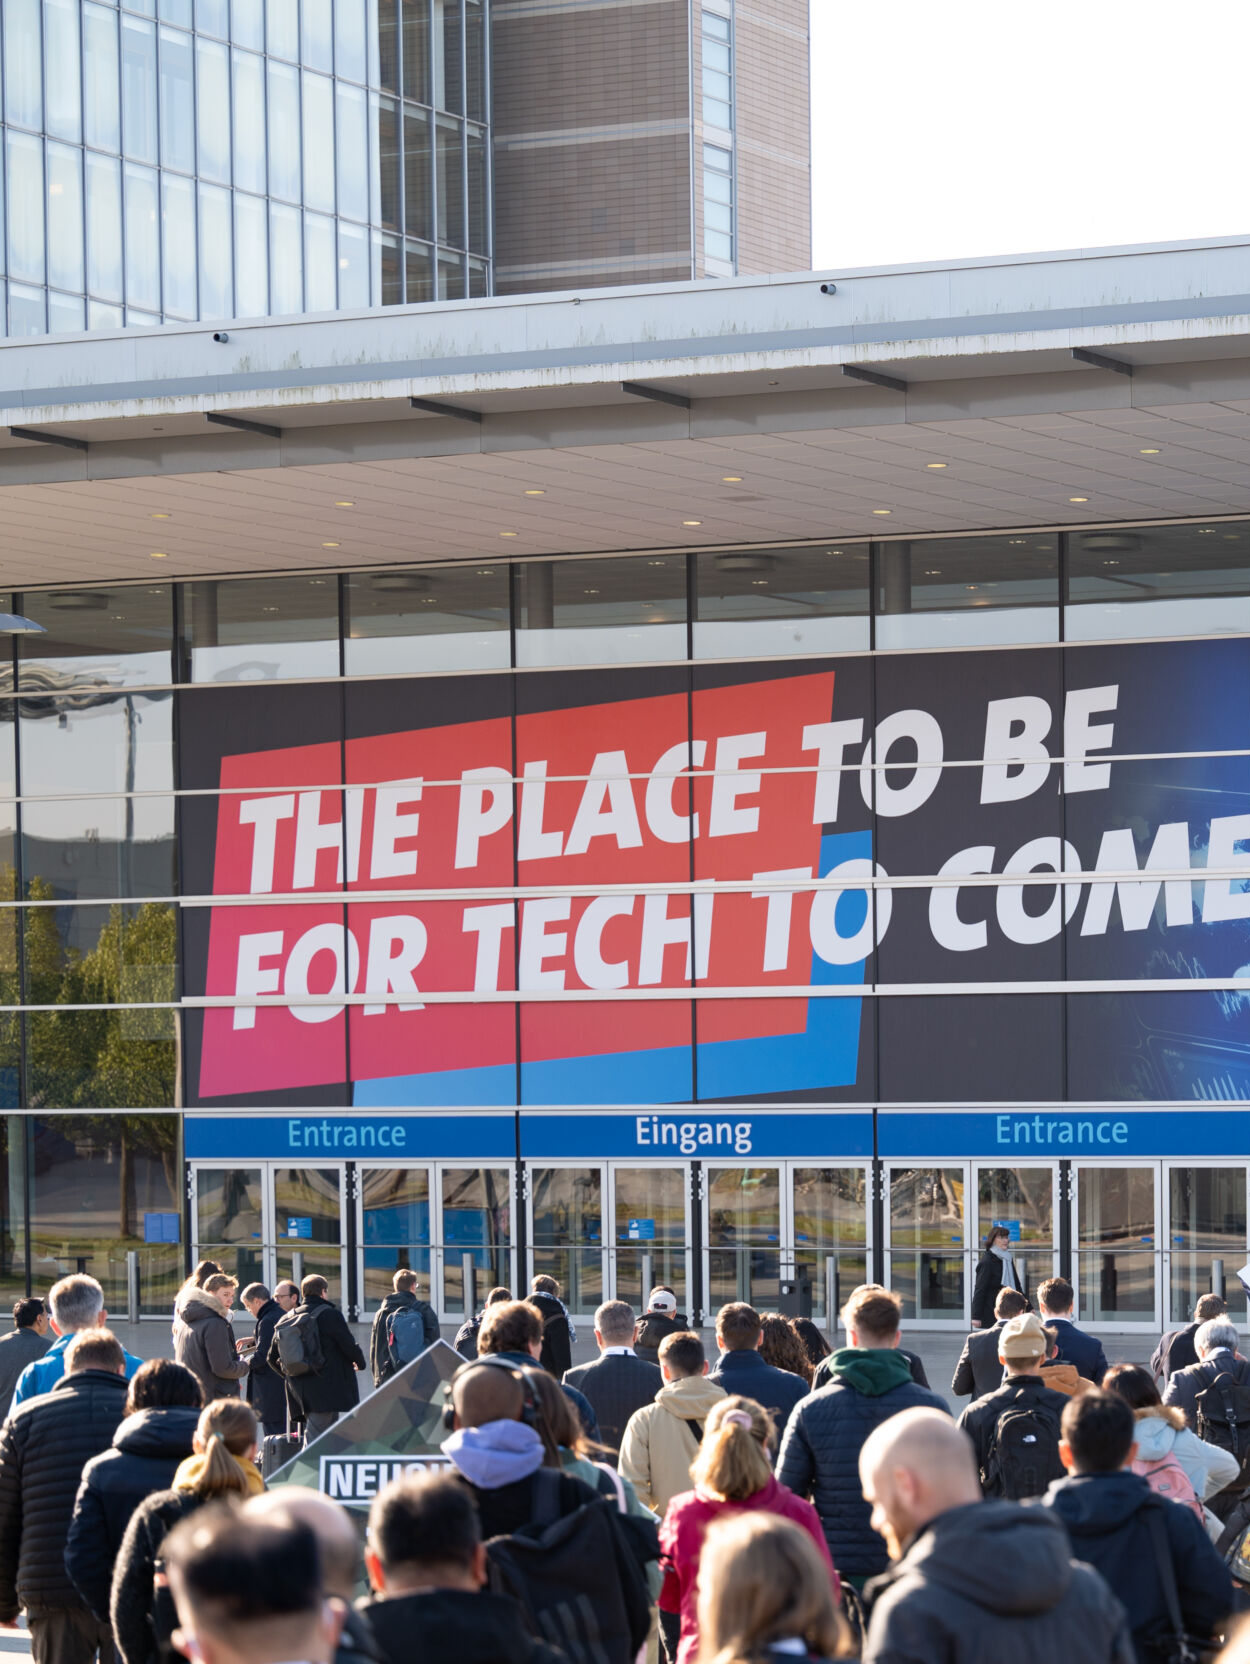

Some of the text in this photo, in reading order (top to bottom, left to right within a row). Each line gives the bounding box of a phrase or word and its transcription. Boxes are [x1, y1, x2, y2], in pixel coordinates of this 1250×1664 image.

[239, 684, 1119, 894] THE PLACE TO BE
[233, 914, 428, 1031] FOR
[462, 879, 716, 1003] TECH
[752, 858, 893, 973] TO
[288, 1118, 407, 1148] Entrance
[635, 1115, 753, 1154] Eingang
[996, 1115, 1129, 1144] Entrance
